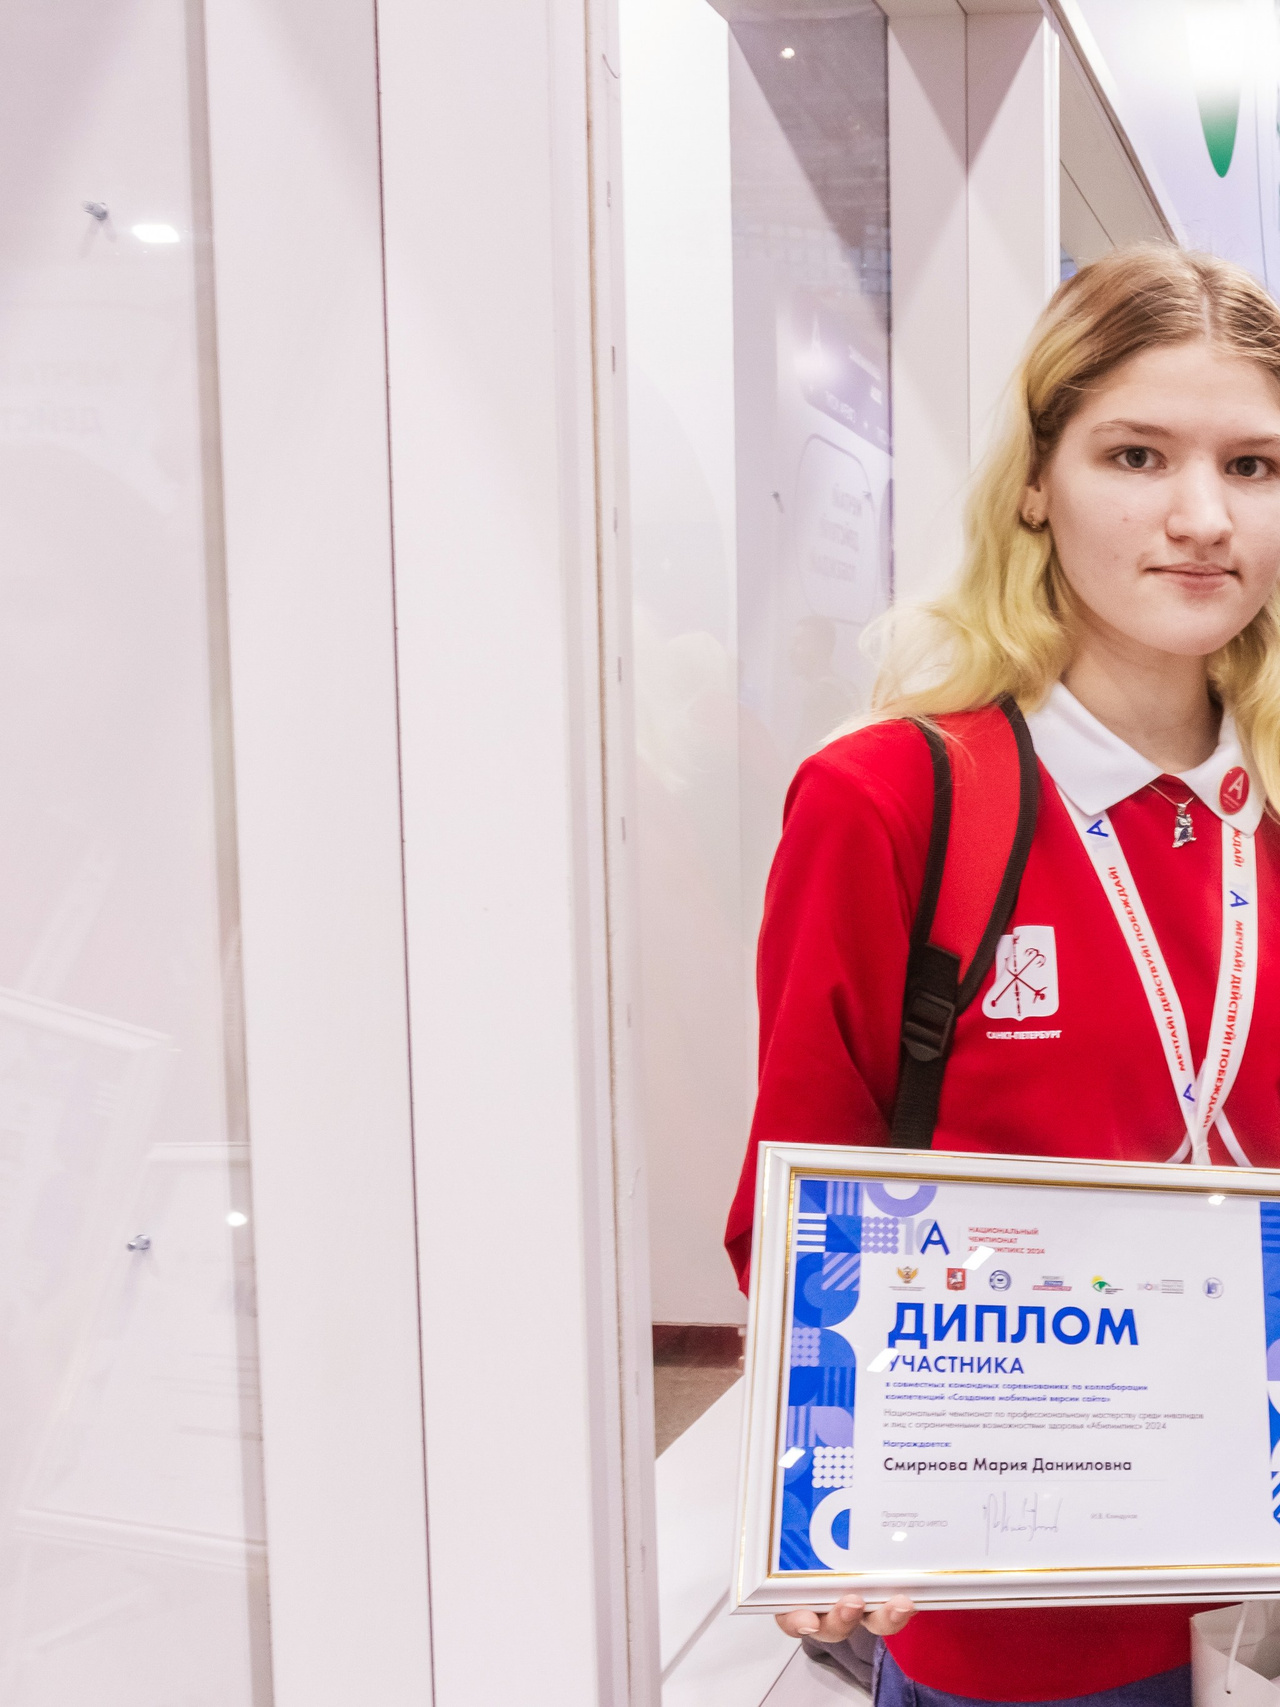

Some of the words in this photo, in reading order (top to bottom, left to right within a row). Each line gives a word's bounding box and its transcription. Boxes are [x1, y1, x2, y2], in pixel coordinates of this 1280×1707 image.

[1108, 866, 1145, 942] ПОБЕЖДАЙ!
[1232, 920, 1246, 972] МЕЧТАЙ!
[1139, 944, 1173, 1013] ДЕЙСТВУЙ!
[1221, 974, 1244, 1045] ДЕЙСТВУЙ!
[1166, 1016, 1186, 1072] МЕЧТАЙ!
[887, 1302, 1139, 1350] ДИПЛОМ
[999, 1393, 1047, 1401] мобильной
[1002, 1383, 1068, 1391] соревнованиях
[1085, 1383, 1148, 1391] коллаборации
[883, 1408, 946, 1418] Национальный
[883, 1457, 968, 1475] Смирнова
[973, 1457, 1028, 1475] Мария
[1032, 1457, 1132, 1473] Данииловна
